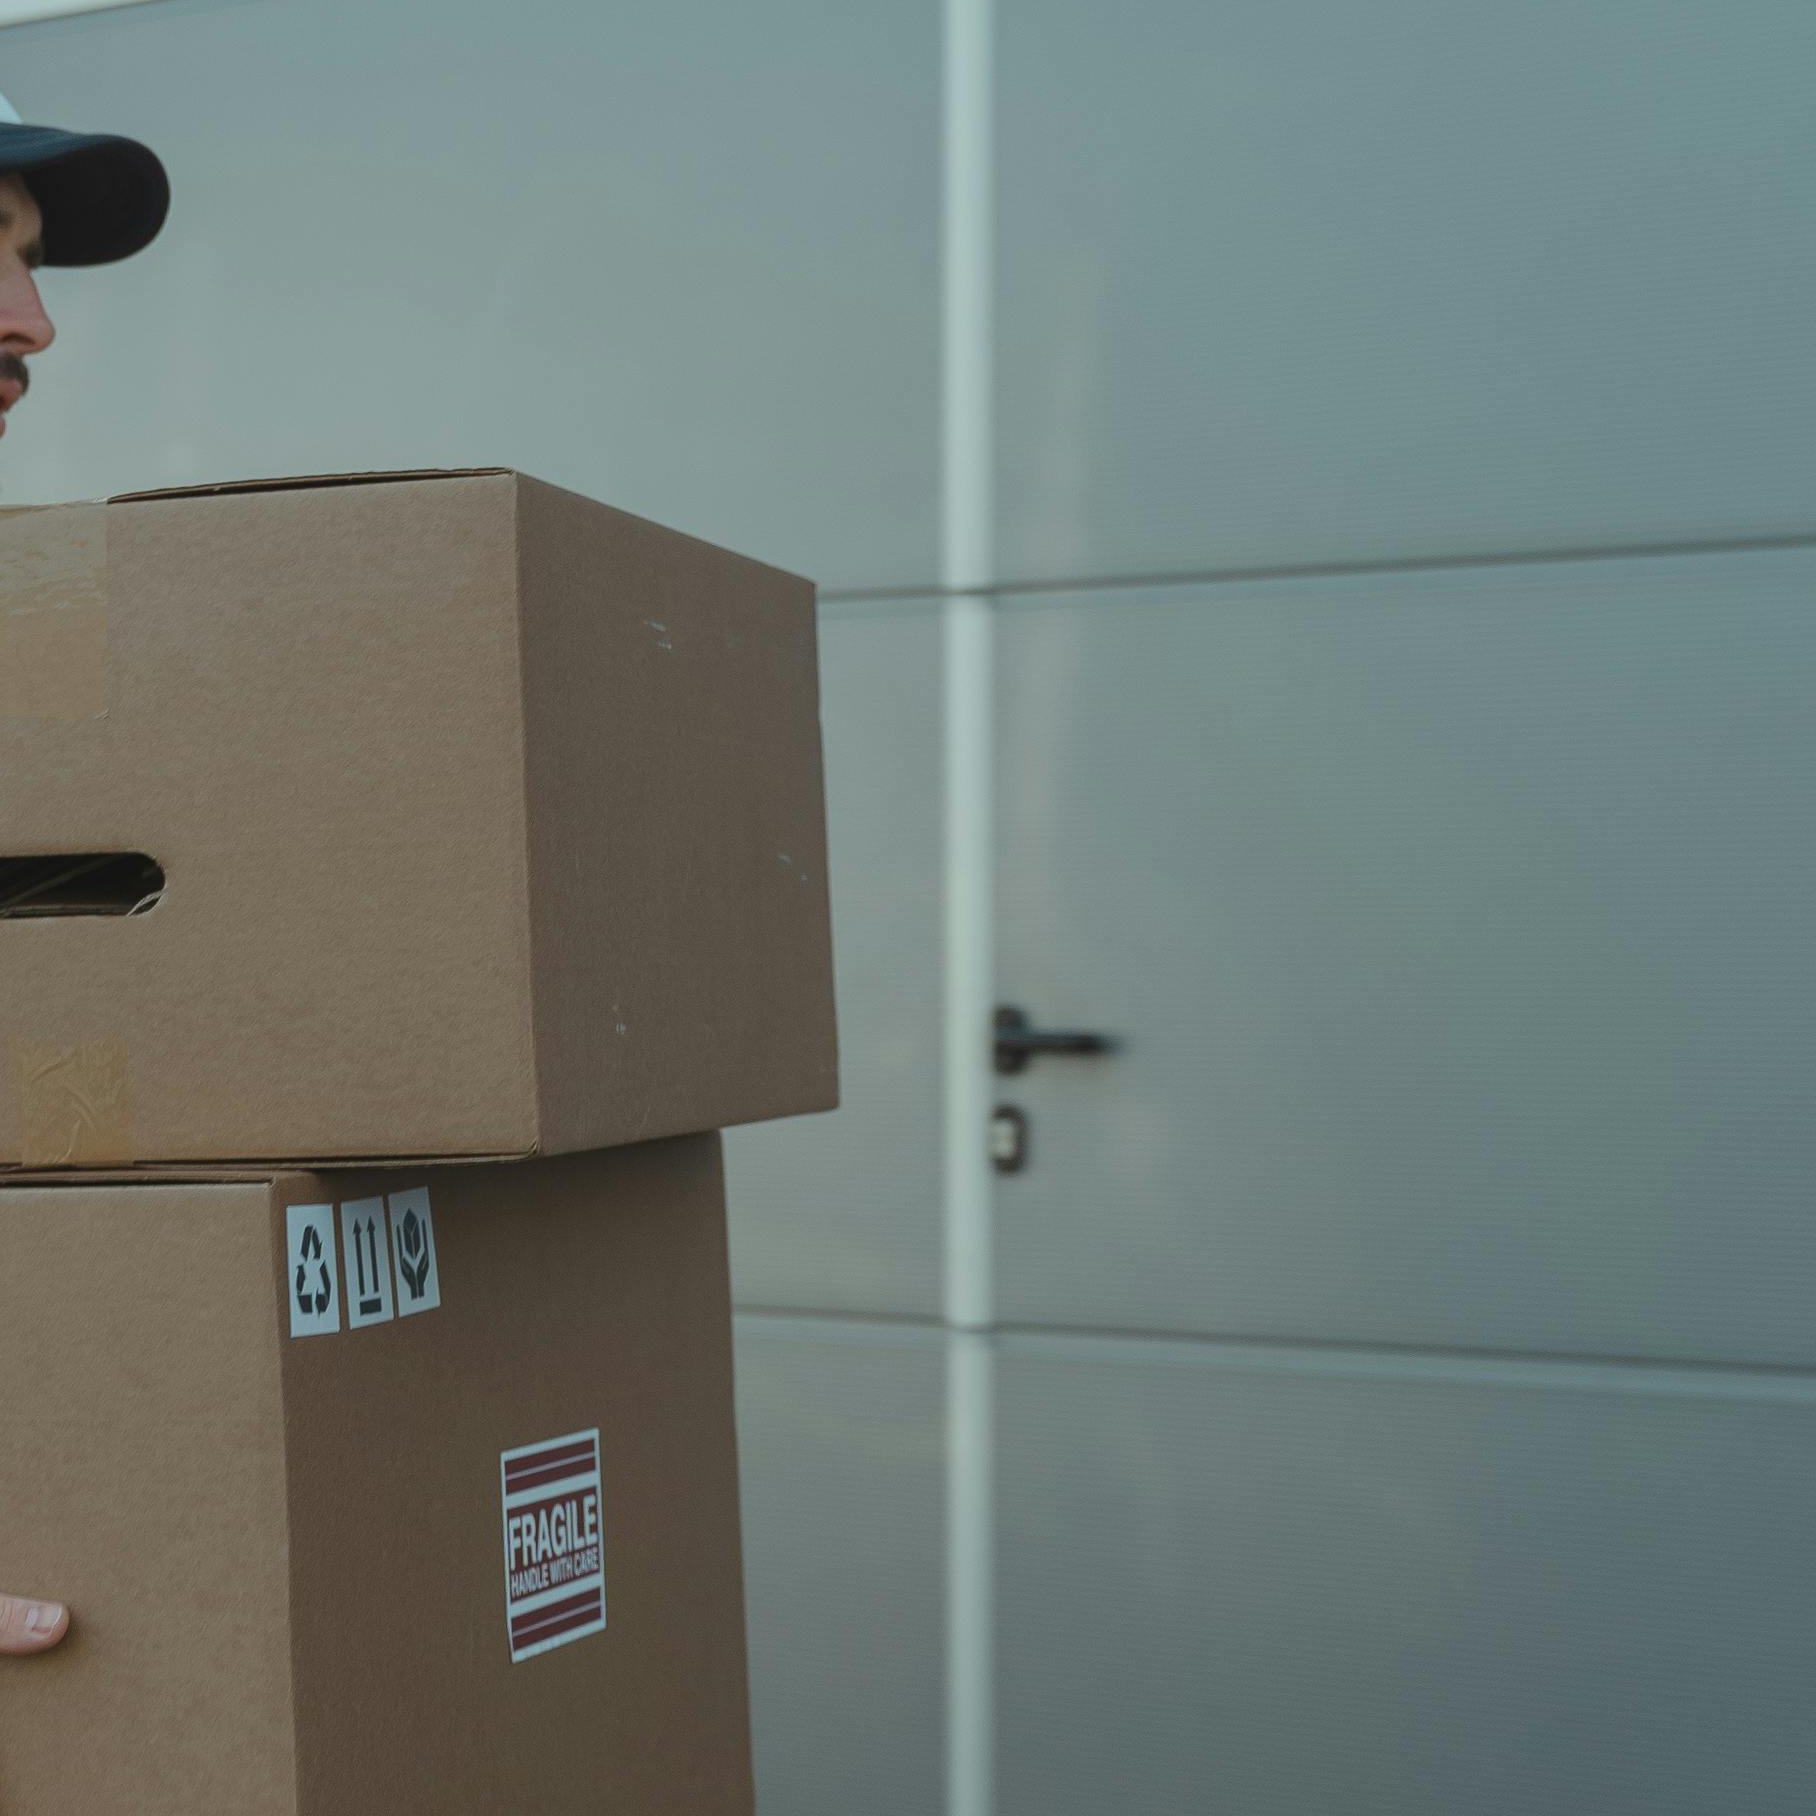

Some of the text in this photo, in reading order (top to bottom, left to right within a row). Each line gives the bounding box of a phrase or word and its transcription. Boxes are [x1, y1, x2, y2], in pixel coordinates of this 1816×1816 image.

[508, 1494, 598, 1570] FRAGILE
[511, 1546, 599, 1598] HANDLE WITH CARE
